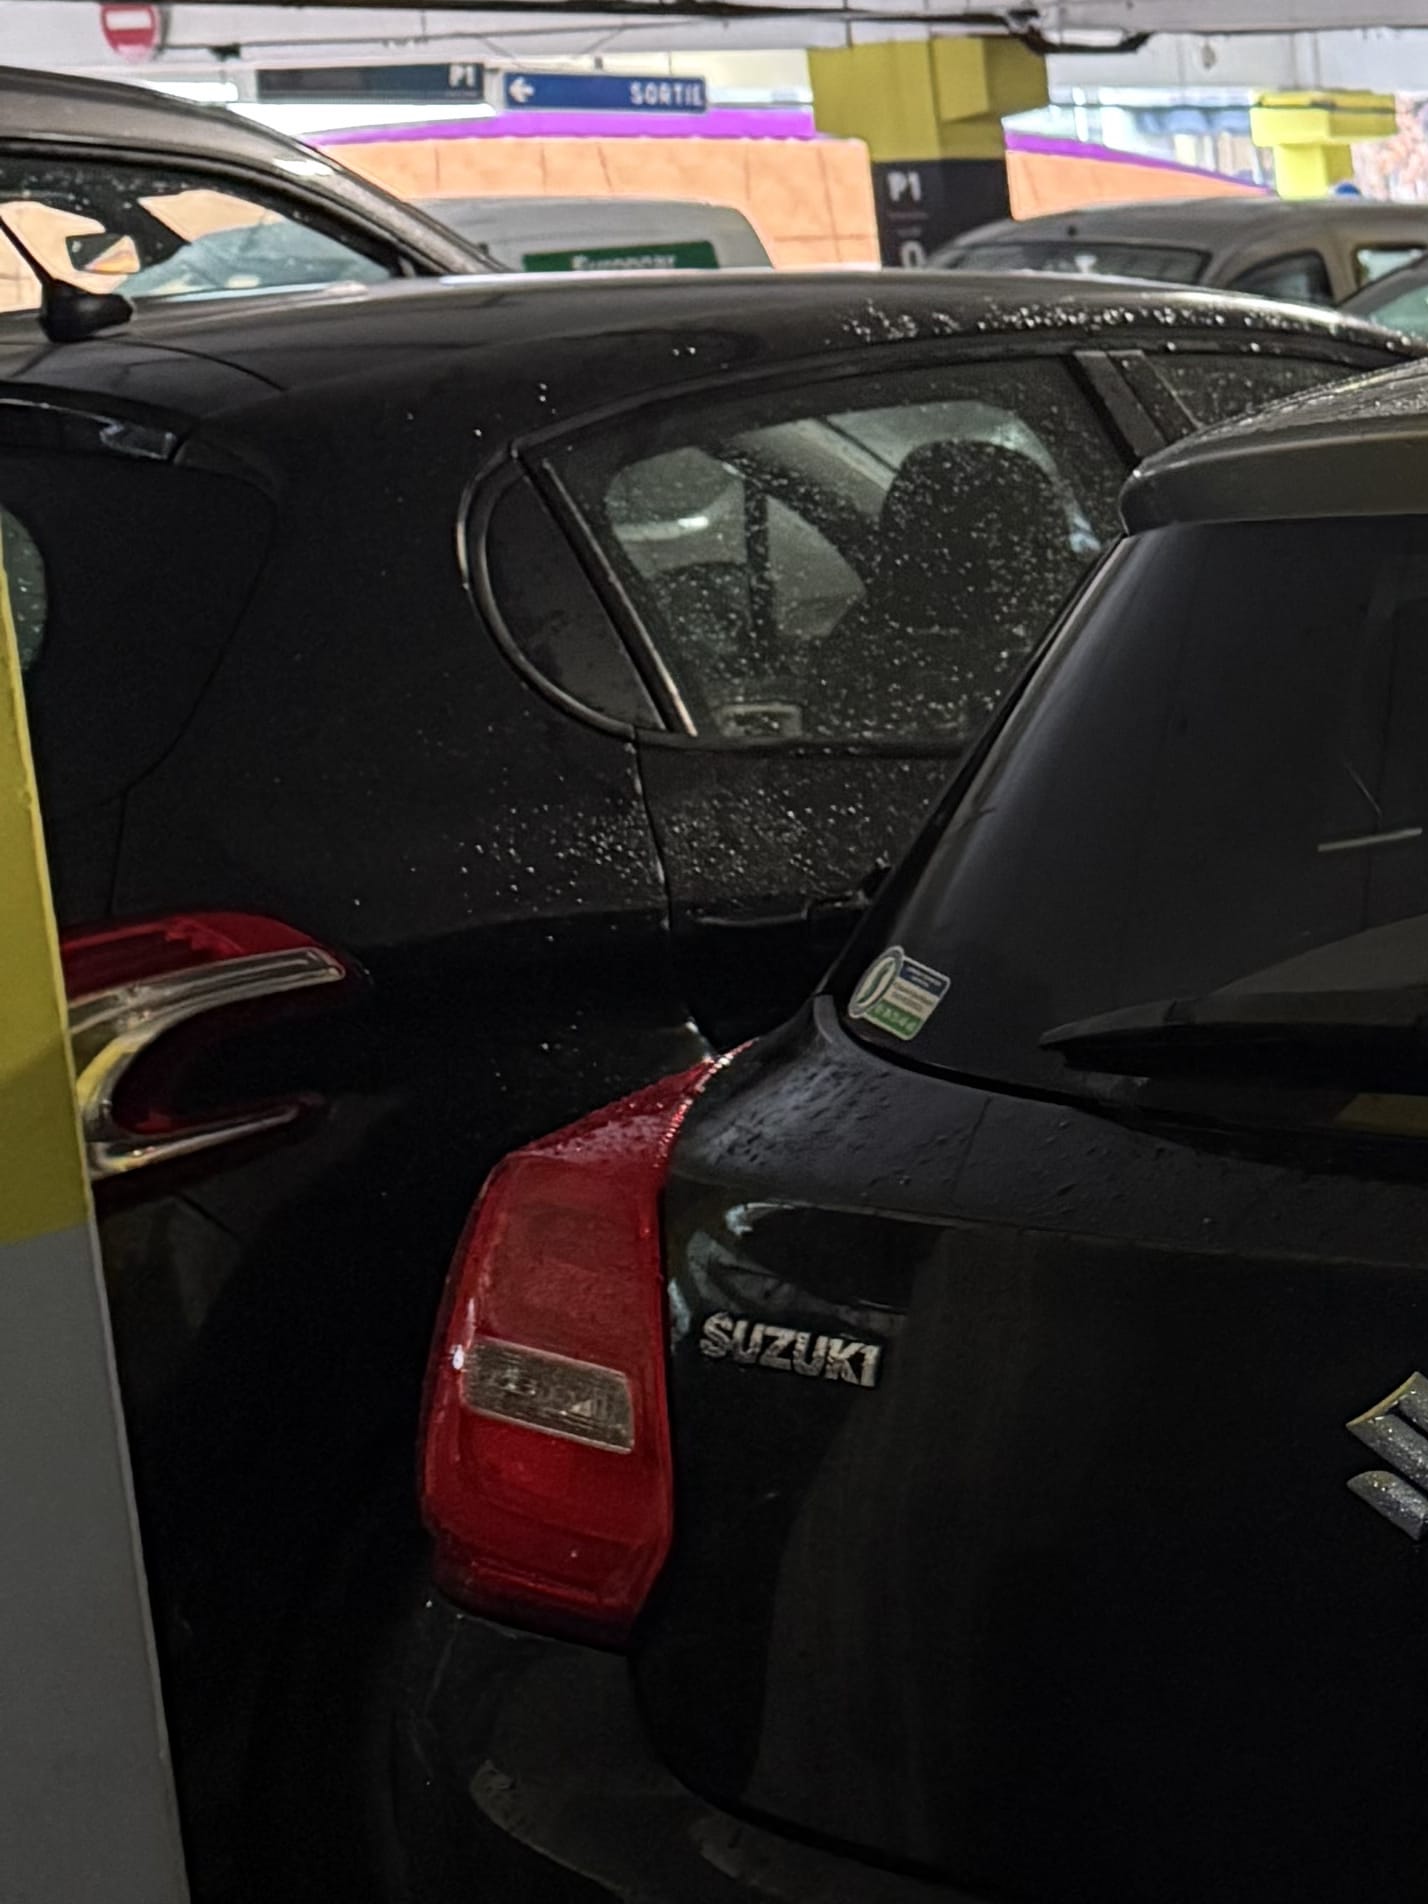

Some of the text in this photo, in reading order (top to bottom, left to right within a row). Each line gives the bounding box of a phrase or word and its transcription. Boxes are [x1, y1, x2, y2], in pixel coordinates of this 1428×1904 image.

[448, 65, 475, 87] P1
[630, 81, 702, 106] SORTIE
[887, 171, 921, 201] P1
[700, 1311, 880, 1388] SUZUKI
